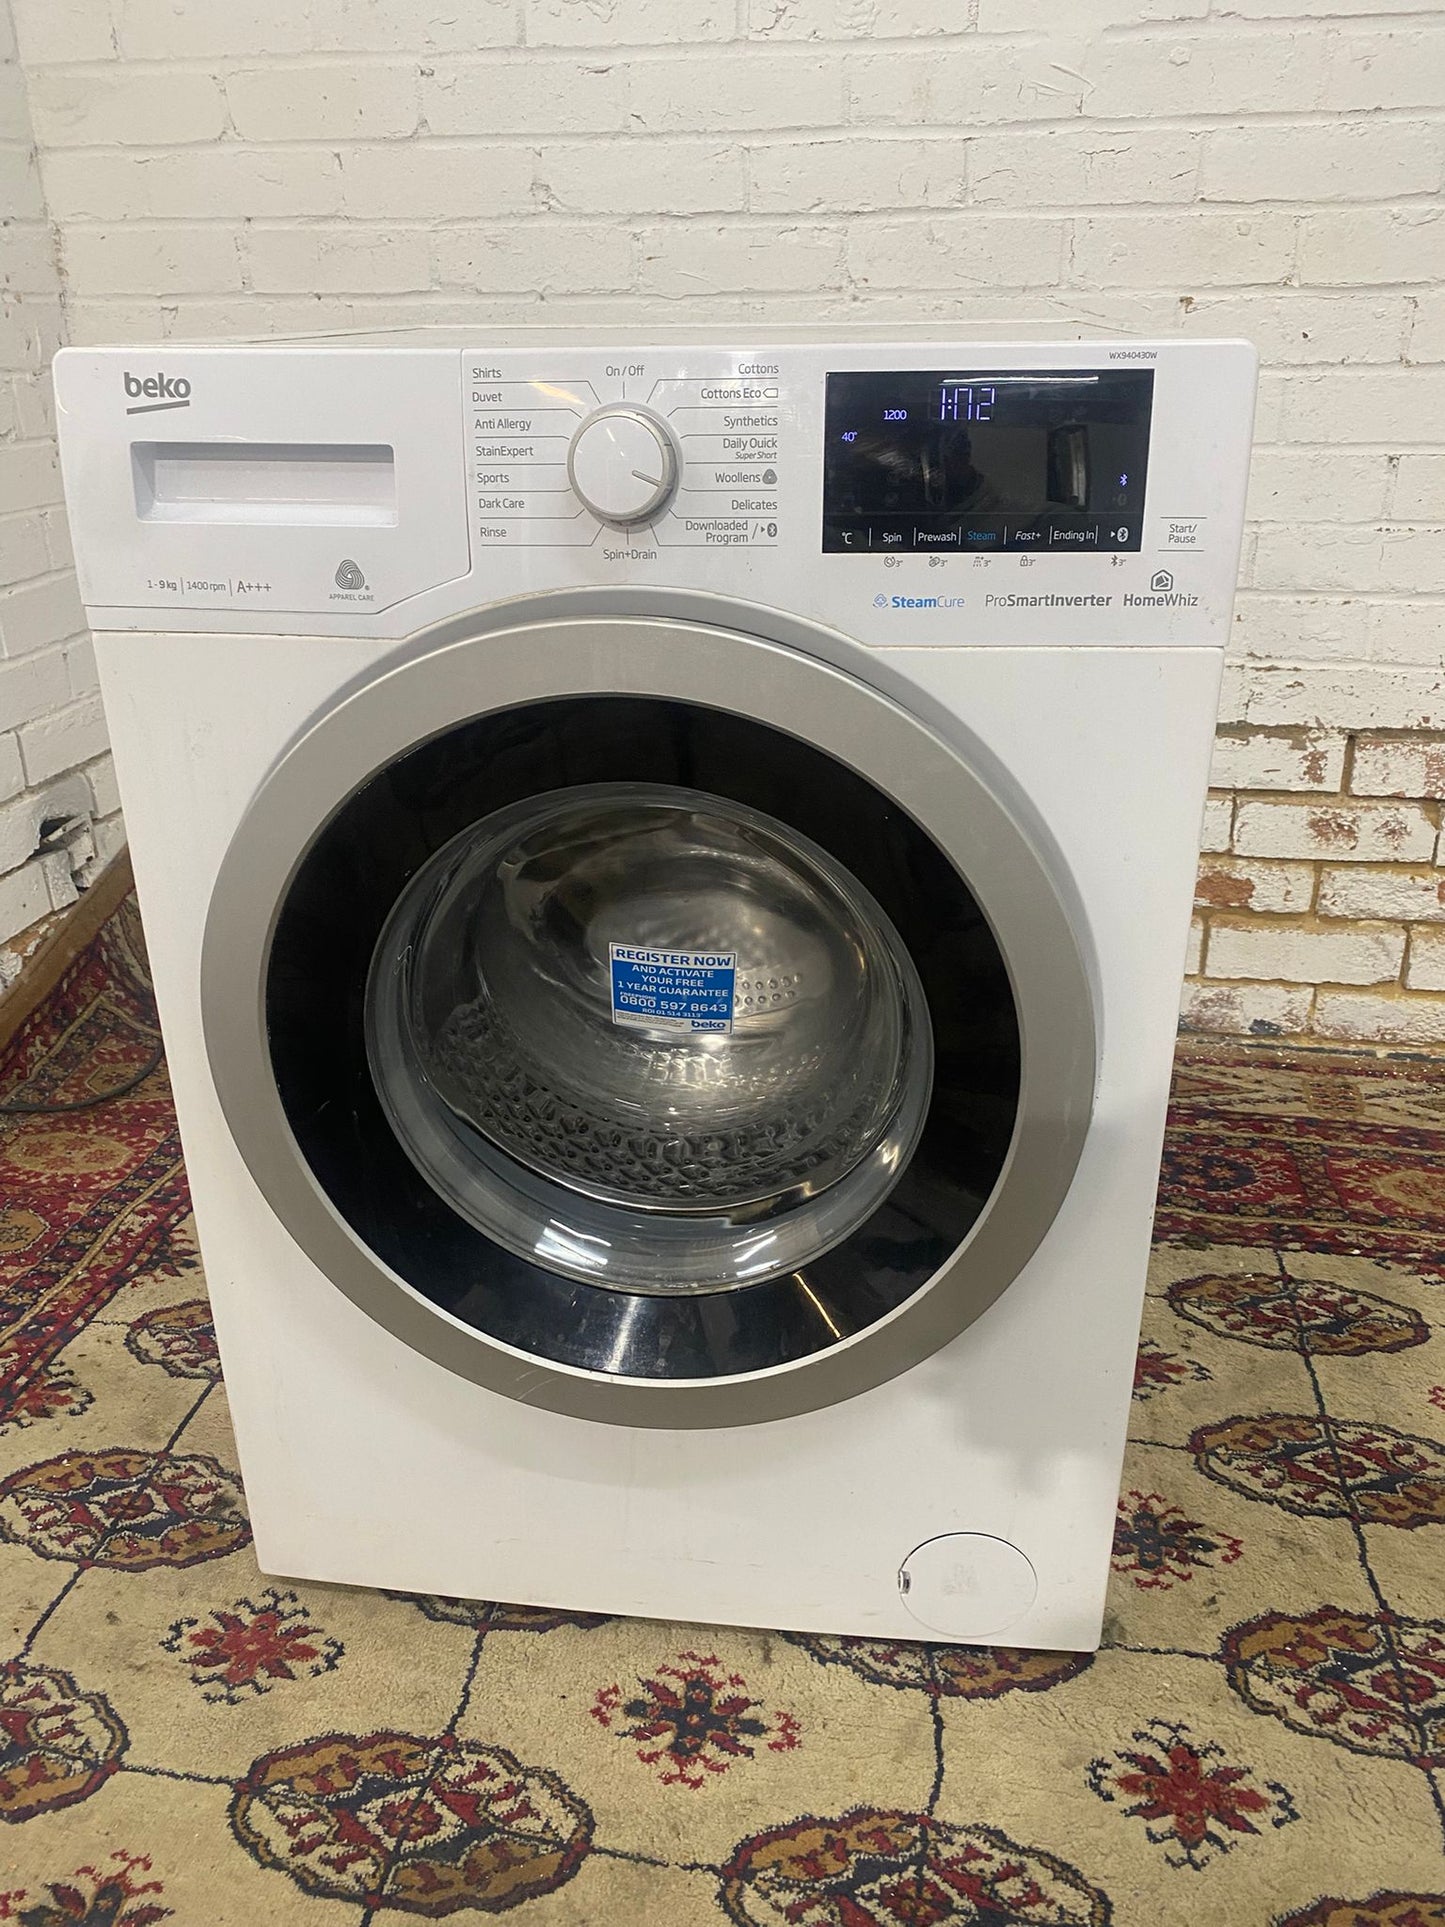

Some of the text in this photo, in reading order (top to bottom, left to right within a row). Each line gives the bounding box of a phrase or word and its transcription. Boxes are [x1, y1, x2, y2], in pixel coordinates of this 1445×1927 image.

[472, 368, 502, 379] Shirts
[606, 365, 620, 376] On
[628, 365, 645, 376] Off
[738, 363, 779, 375] Cottons
[124, 372, 191, 398] beko
[472, 391, 502, 402] Duvet
[700, 388, 762, 399] Cottons Eco
[884, 410, 907, 420] 1200
[475, 418, 532, 432] Anti Allergy
[724, 416, 778, 428] Synthetics
[841, 431, 858, 442] 40°
[723, 438, 778, 450] Daily Quick
[476, 445, 534, 458] StainExpert
[735, 452, 778, 460] Super Short
[477, 472, 510, 486] Sports
[715, 472, 761, 483] Woollens
[478, 498, 525, 510] Dark Care
[732, 500, 778, 510] Delicates
[685, 520, 748, 531] Downloaded
[1169, 524, 1198, 534] Start/
[480, 526, 507, 538] Rinse
[882, 532, 902, 544] Spin
[918, 532, 957, 542] Prewash
[967, 530, 996, 541] Steam
[1015, 530, 1042, 540] Fast+
[1053, 530, 1095, 542] Ending In
[706, 532, 749, 546] Program
[1168, 534, 1196, 544] Pause
[603, 549, 657, 561] Spin+Drain
[186, 580, 226, 592] 1400 rpm
[237, 580, 272, 594] A+++
[329, 593, 374, 602] APPAREL CARE
[892, 595, 965, 608] SteamCure
[985, 594, 1112, 607] ProSmartInverter
[1123, 594, 1198, 606] HomeWhiz
[616, 948, 732, 966] REGISTER NOW
[632, 964, 714, 978] AND ACTIVATE
[642, 975, 704, 987] YOUR FREE
[618, 980, 729, 997] 1 YEAR GUARANTEE
[620, 996, 728, 1012] 0800 597 8643
[691, 1020, 726, 1029] beko
